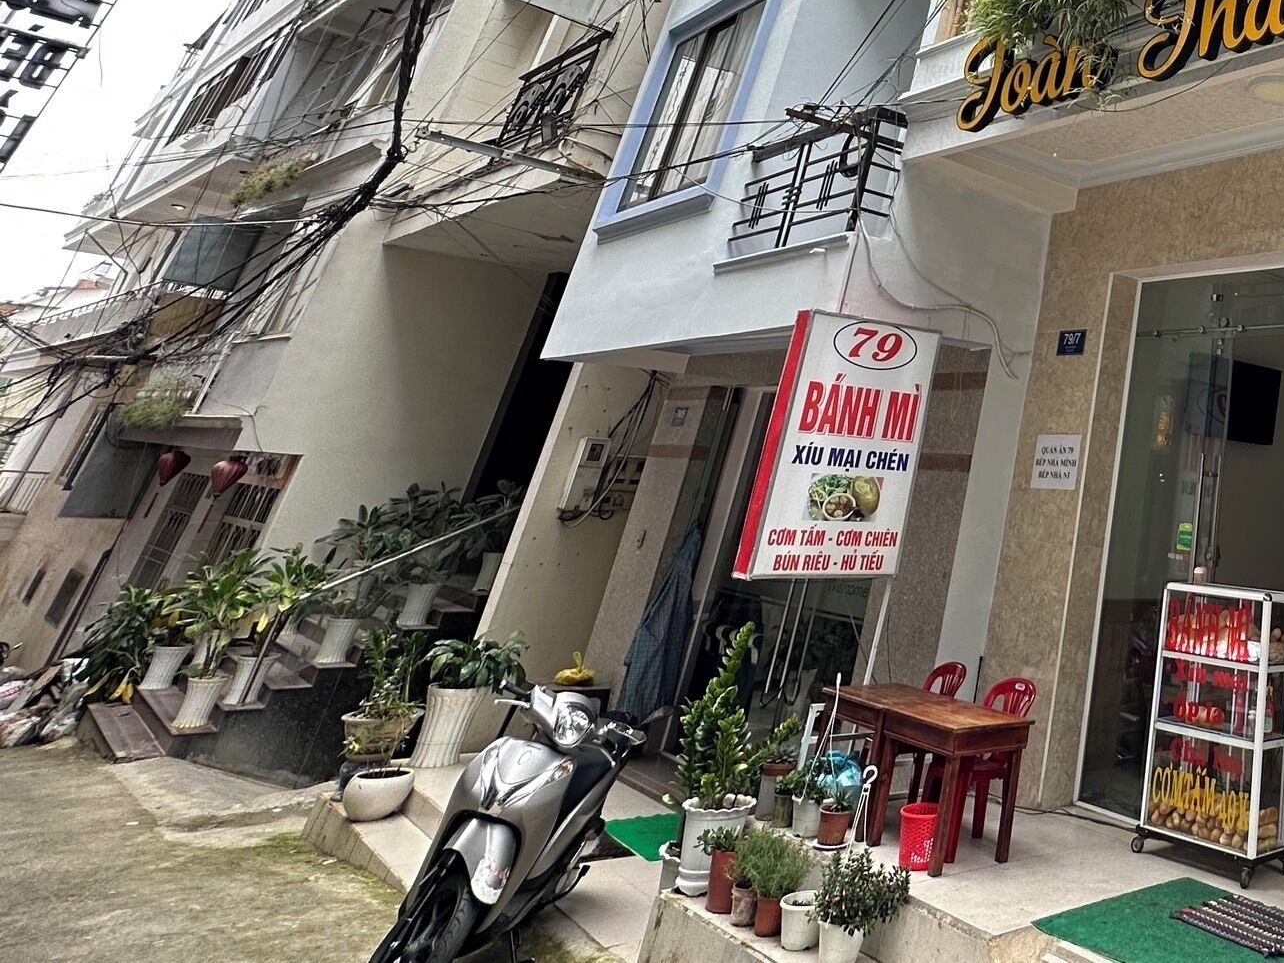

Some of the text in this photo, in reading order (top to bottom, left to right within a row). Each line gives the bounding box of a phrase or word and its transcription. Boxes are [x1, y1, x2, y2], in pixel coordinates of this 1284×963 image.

[848, 326, 904, 363] 79
[1063, 332, 1082, 345] 79/7
[798, 373, 921, 441] BÁNH MÌ
[792, 442, 910, 472] XÍU MẠI CHÉN
[767, 524, 898, 547] CƠM TẤM CƠM CHIÊN
[772, 549, 884, 571] BÚN RIÊU HỦ TIẾU
